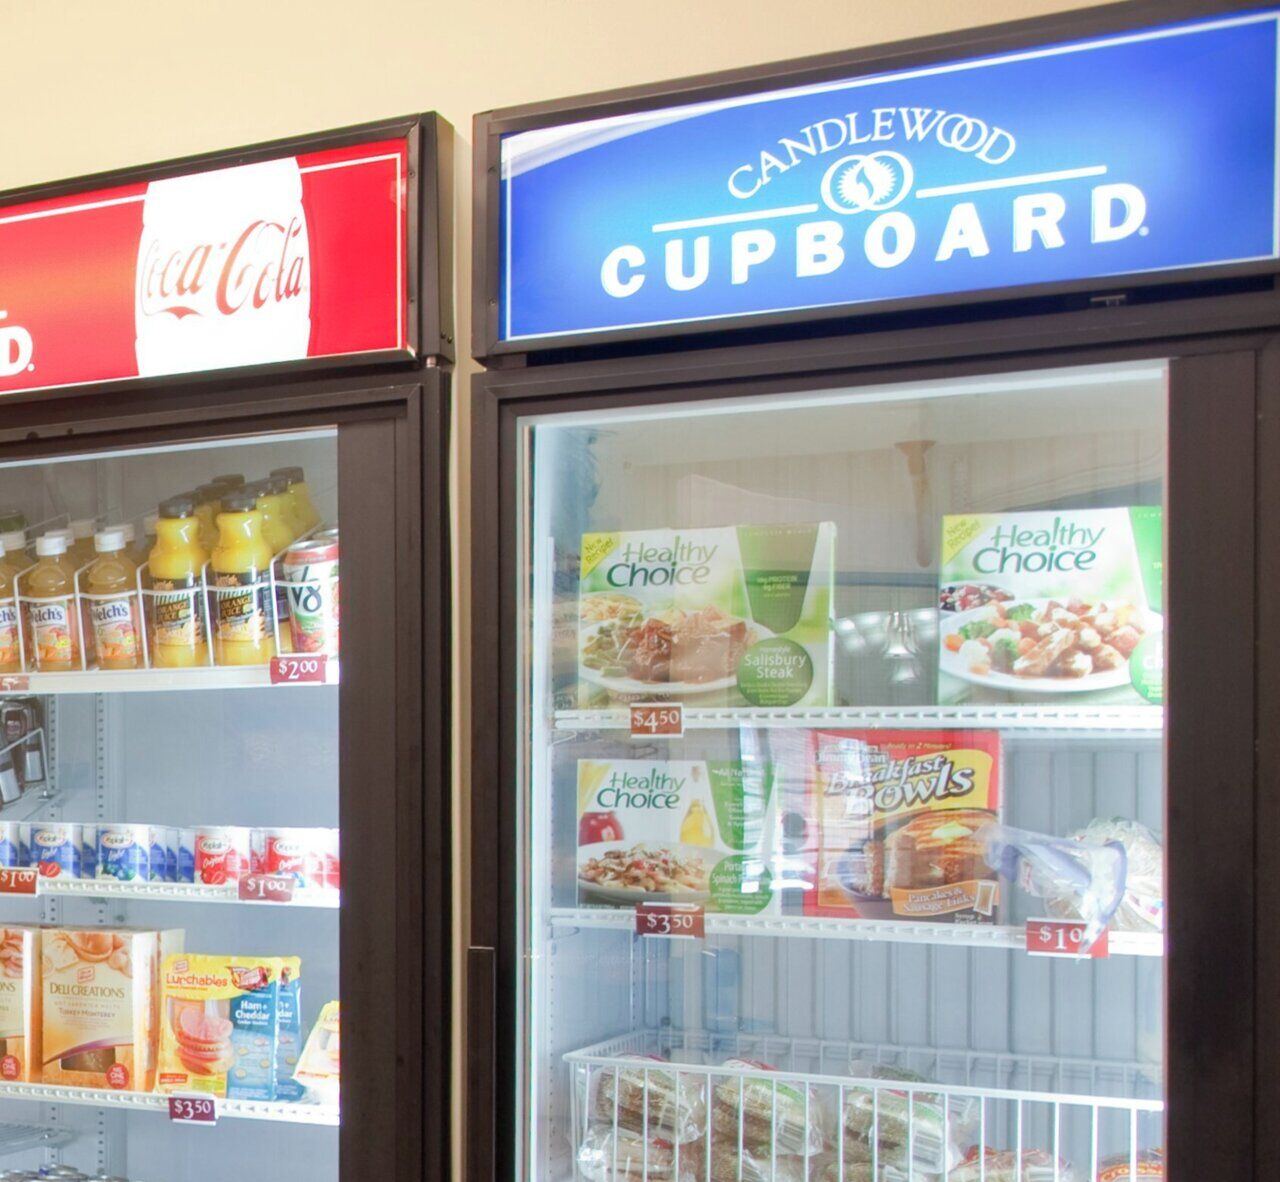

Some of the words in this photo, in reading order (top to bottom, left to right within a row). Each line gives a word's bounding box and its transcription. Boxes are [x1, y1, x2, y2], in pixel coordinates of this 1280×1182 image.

[727, 107, 1018, 198] CANDLEWOOD
[600, 183, 1149, 298] CUPBOARD
[141, 215, 308, 320] Coca-Cola
[990, 516, 1106, 548] Healthy
[622, 535, 719, 564] Healthy
[973, 545, 1096, 574] Choice
[607, 561, 711, 588] Choice
[292, 566, 323, 614] V8
[744, 652, 808, 668] Salisbury
[756, 666, 794, 679] Steak
[608, 767, 687, 791] Healthy
[596, 787, 681, 809] Choice
[49, 982, 71, 995] DELI
[71, 983, 125, 999] CREATIONS
[166, 973, 228, 987] Lunchables
[235, 1010, 271, 1020] Cheddar
[240, 1000, 261, 1010] Ham
